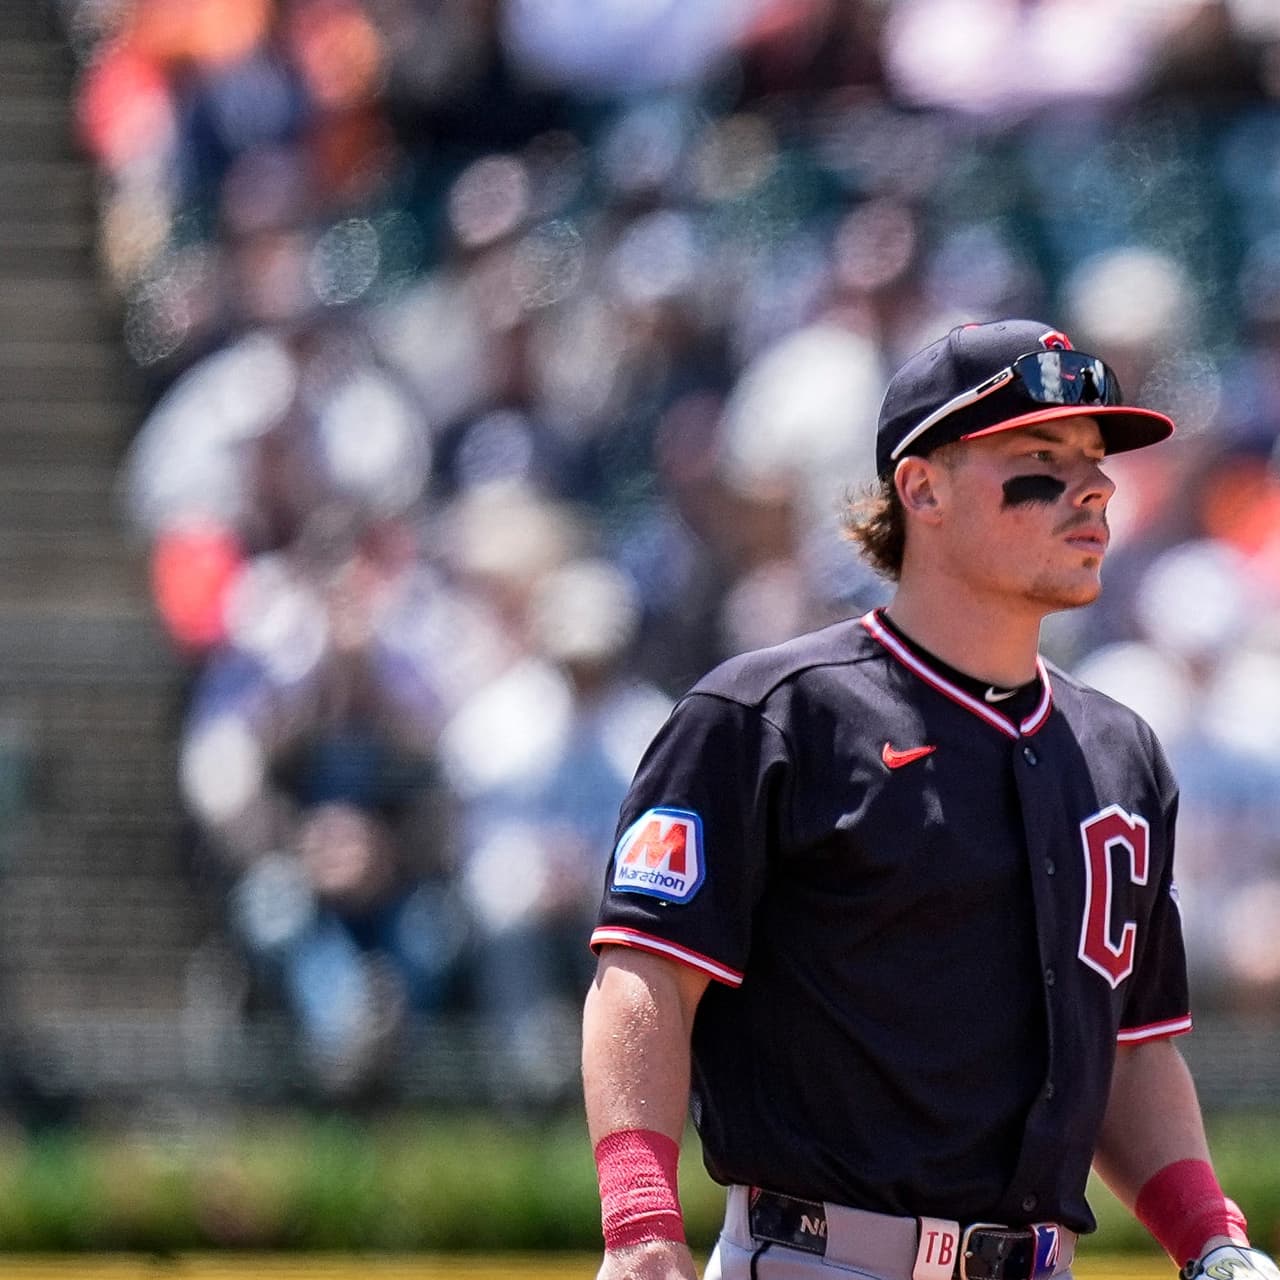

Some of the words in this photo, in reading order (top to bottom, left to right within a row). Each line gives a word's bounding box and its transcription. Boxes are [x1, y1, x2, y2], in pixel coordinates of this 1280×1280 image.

[624, 821, 687, 875] M
[619, 866, 685, 892] Marathon
[1078, 804, 1150, 990] C
[925, 1231, 954, 1266] TB
